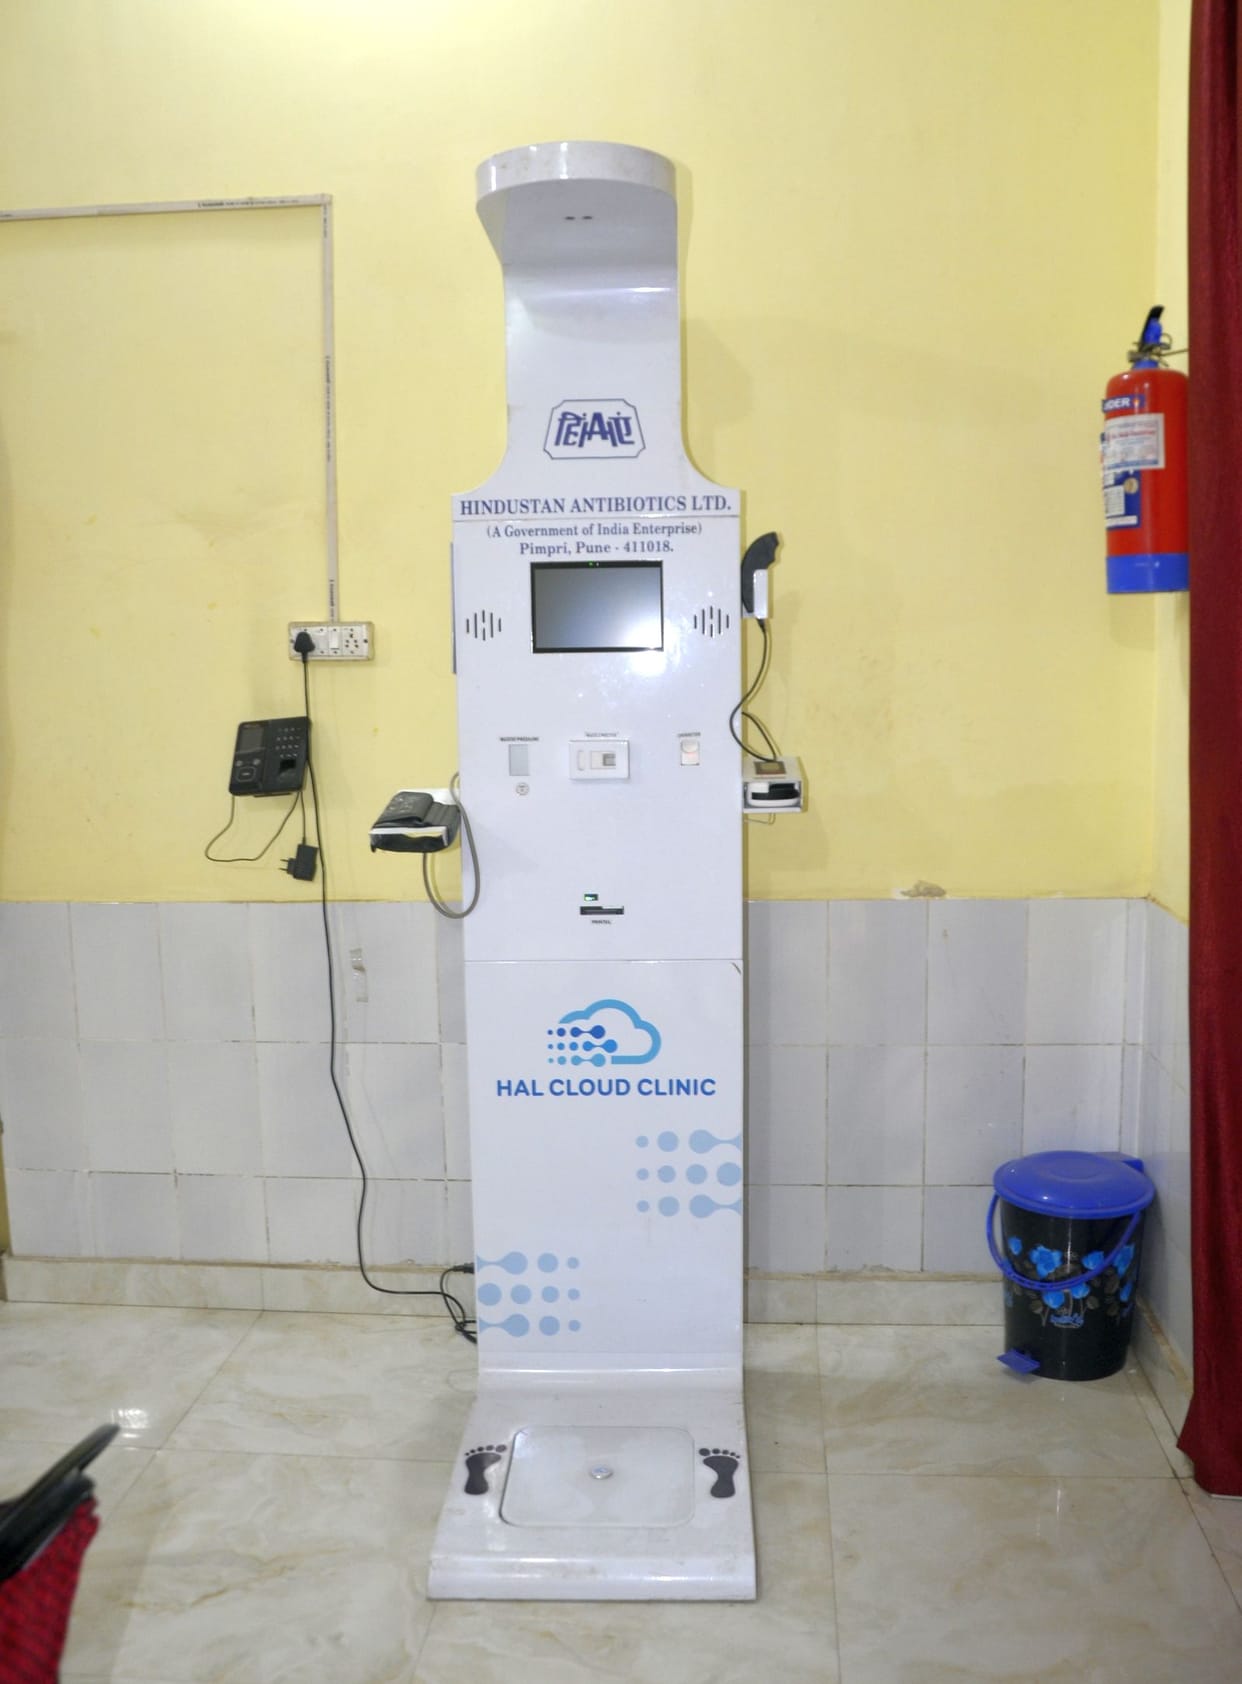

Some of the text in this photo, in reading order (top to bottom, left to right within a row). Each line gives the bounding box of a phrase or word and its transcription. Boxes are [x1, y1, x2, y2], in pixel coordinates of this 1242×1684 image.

[460, 495, 732, 516] HINDUSTAN ANTIBIOTICS LTD.
[486, 522, 703, 538] (A Government of India Enterprise)
[519, 542, 572, 556] Pimpri,
[575, 541, 612, 554] Pune
[623, 540, 674, 553] 411018.
[496, 1078, 717, 1096] HAL CLOUD CLINIC
